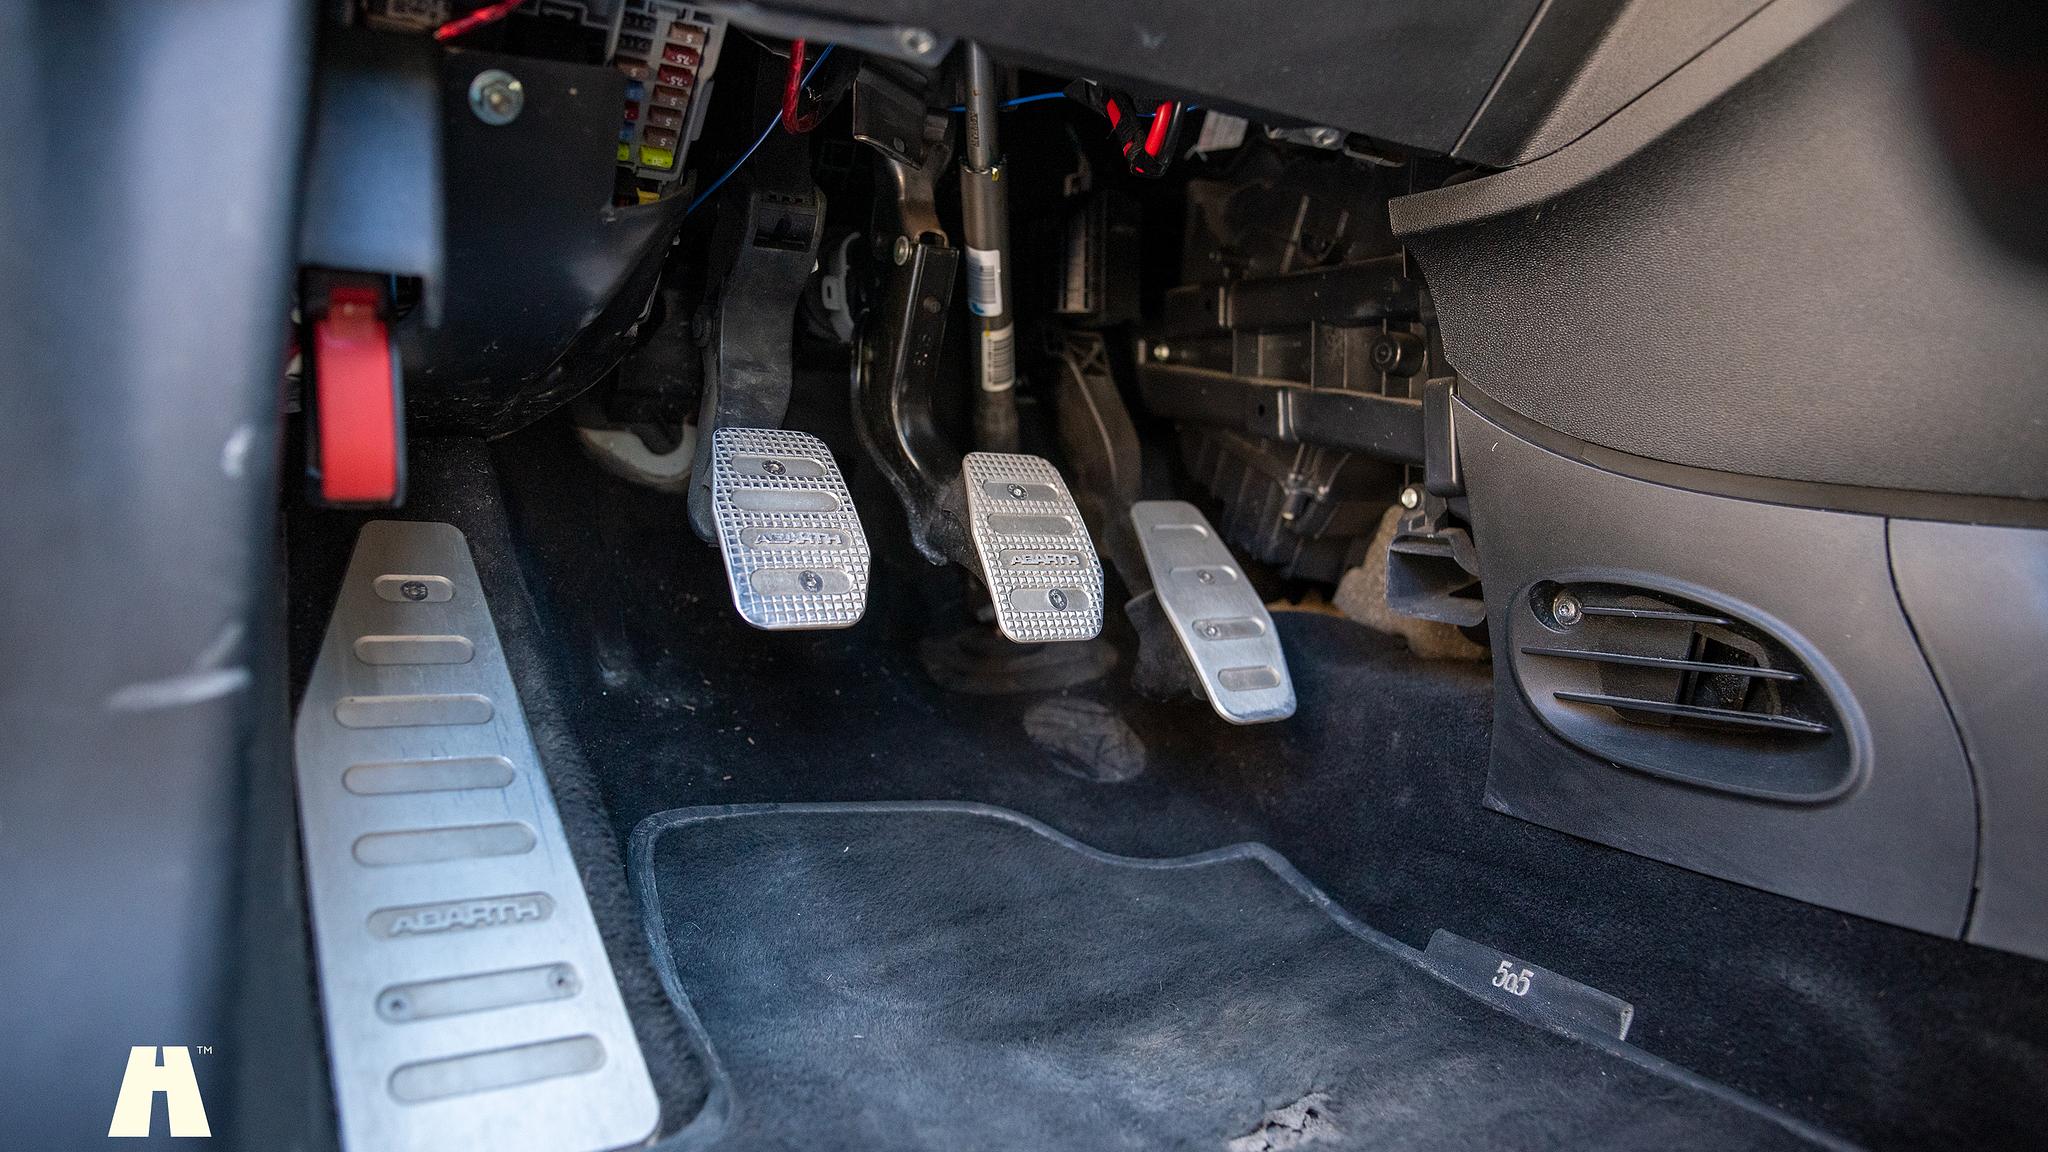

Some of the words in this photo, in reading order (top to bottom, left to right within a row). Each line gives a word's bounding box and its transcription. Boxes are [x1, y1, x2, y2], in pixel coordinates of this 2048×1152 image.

[755, 532, 842, 544] ABARTH
[1012, 553, 1080, 566] ABARTH
[387, 901, 542, 937] ABARTH
